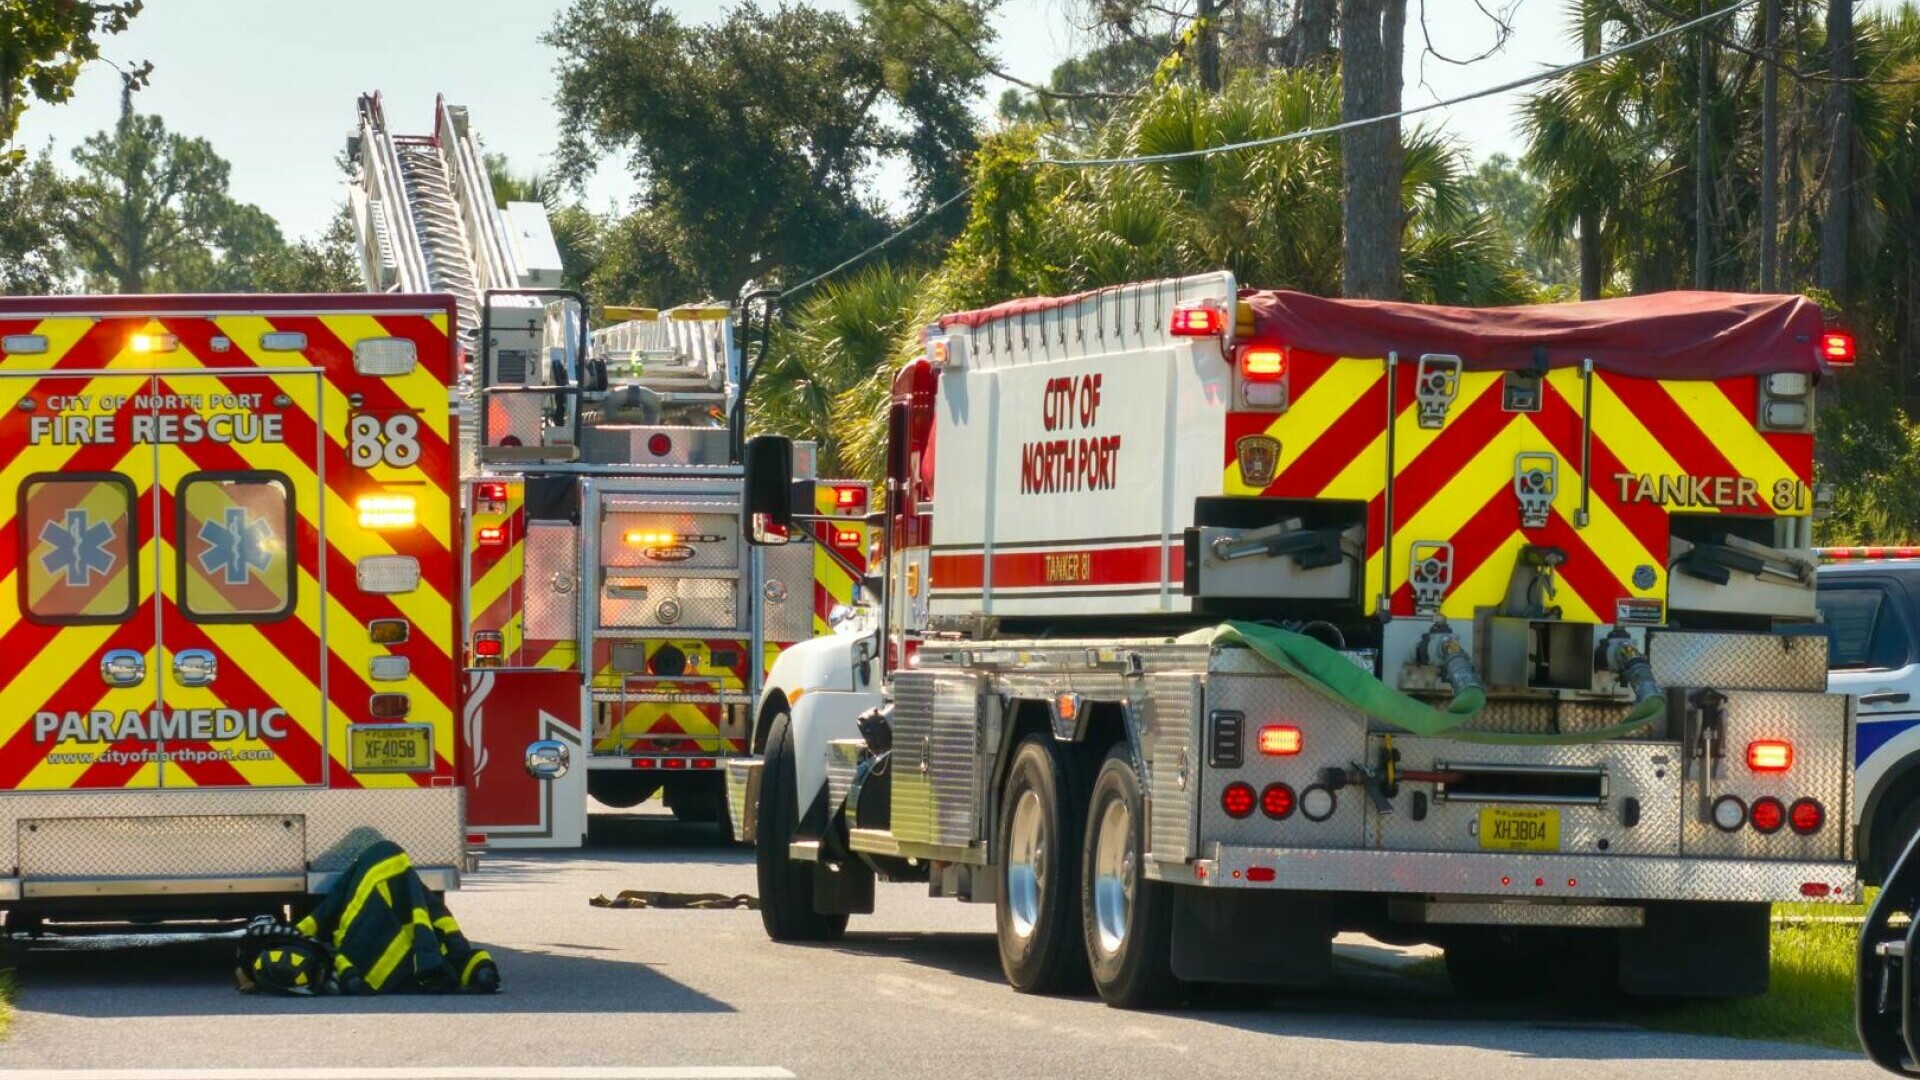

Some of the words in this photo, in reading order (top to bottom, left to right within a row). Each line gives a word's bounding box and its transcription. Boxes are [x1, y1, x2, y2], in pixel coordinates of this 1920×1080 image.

[46, 394, 91, 411] CITY
[100, 394, 127, 410] OF
[134, 394, 202, 410] NORTH
[211, 393, 263, 409] PORT
[1043, 375, 1079, 432] CITY
[1080, 373, 1102, 429] OF
[30, 415, 115, 445] FIRE
[132, 413, 284, 444] RESCUE
[1021, 438, 1076, 495] NORTH
[1077, 434, 1121, 492] PORT
[1613, 473, 1759, 507] TANKER
[1772, 478, 1806, 510] 81
[1046, 553, 1079, 581] TANKER
[35, 707, 288, 743] PARAMEDIC
[47, 748, 275, 765] www.cityofnorthport.com
